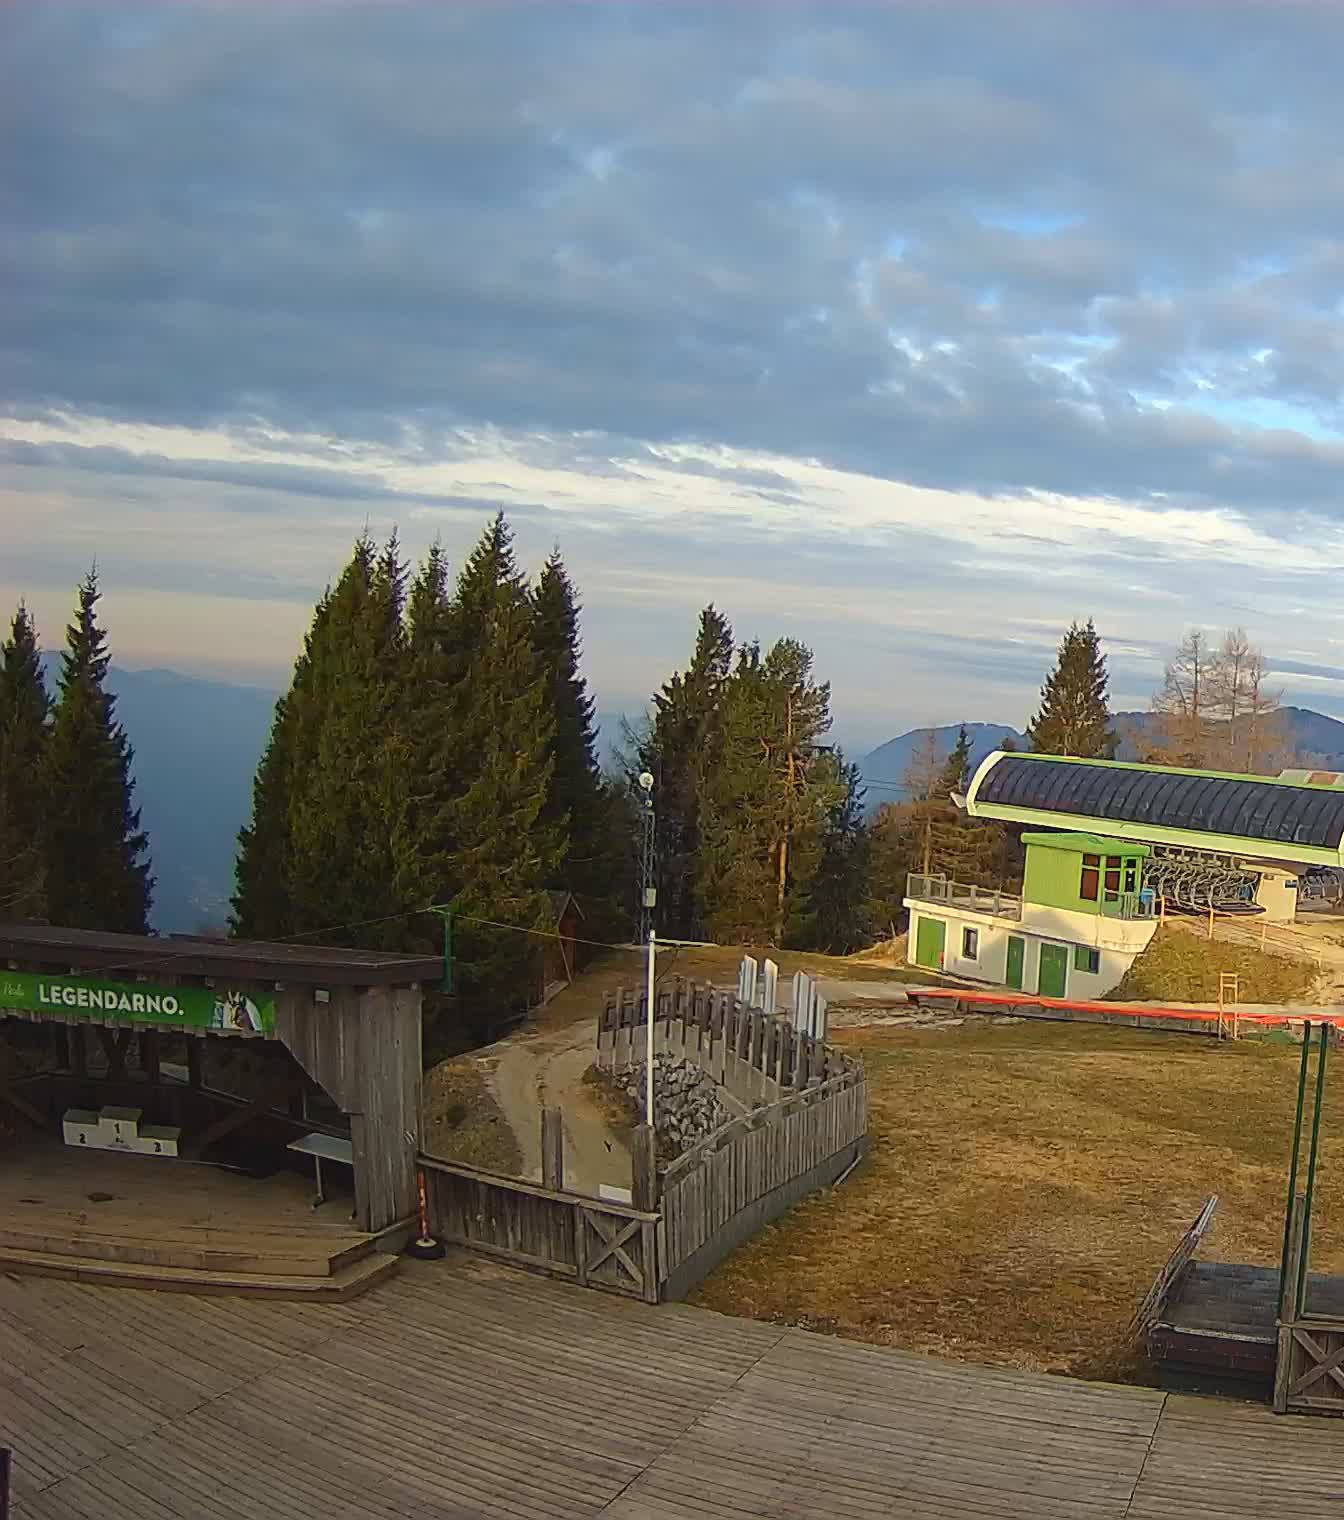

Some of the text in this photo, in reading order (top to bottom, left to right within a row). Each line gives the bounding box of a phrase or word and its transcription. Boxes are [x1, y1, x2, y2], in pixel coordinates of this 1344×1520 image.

[38, 983, 185, 1016] LEGENDARNO.
[114, 1123, 121, 1134] 1
[79, 1133, 86, 1144] 2
